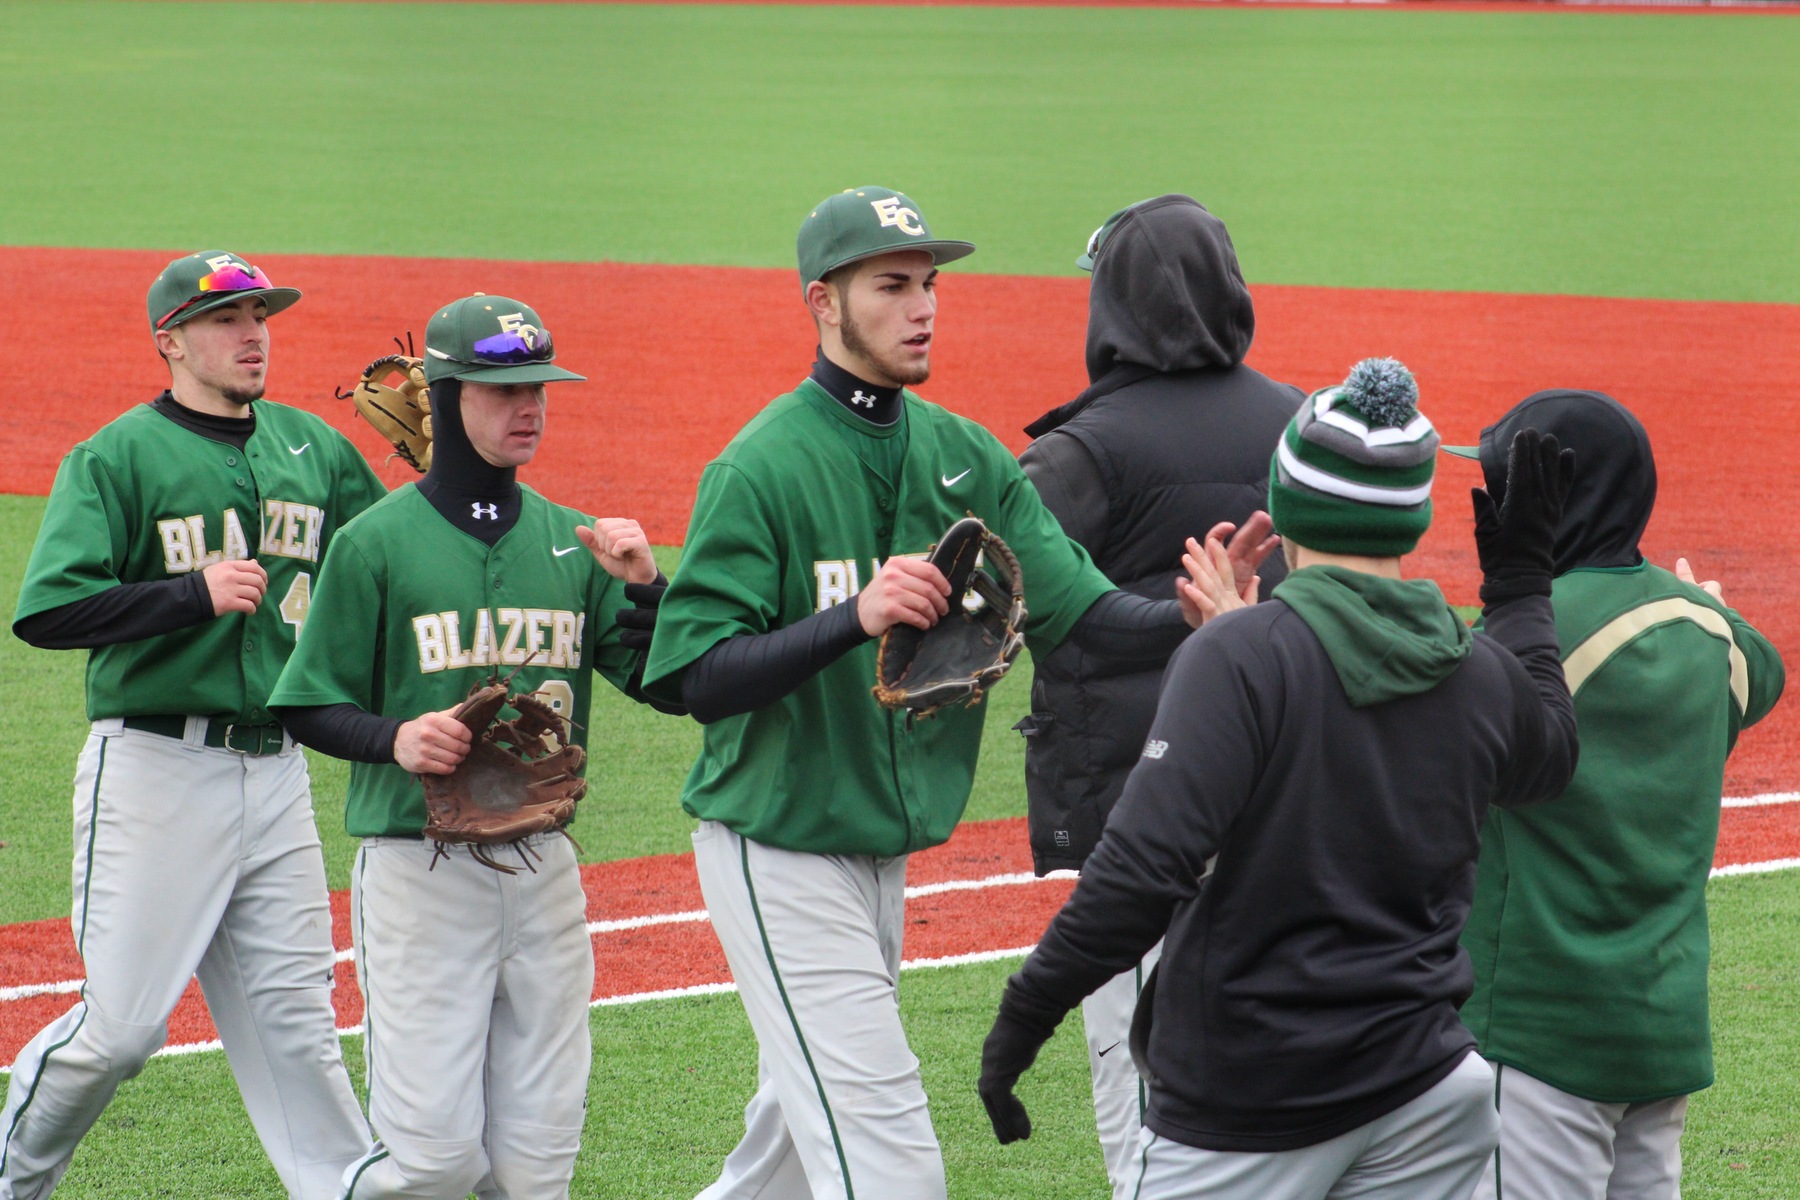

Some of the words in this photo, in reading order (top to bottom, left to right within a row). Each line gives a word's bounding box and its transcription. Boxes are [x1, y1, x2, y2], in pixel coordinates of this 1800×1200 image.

[870, 196, 925, 236] EC
[156, 499, 325, 574] BLAZER
[279, 571, 311, 641] 4
